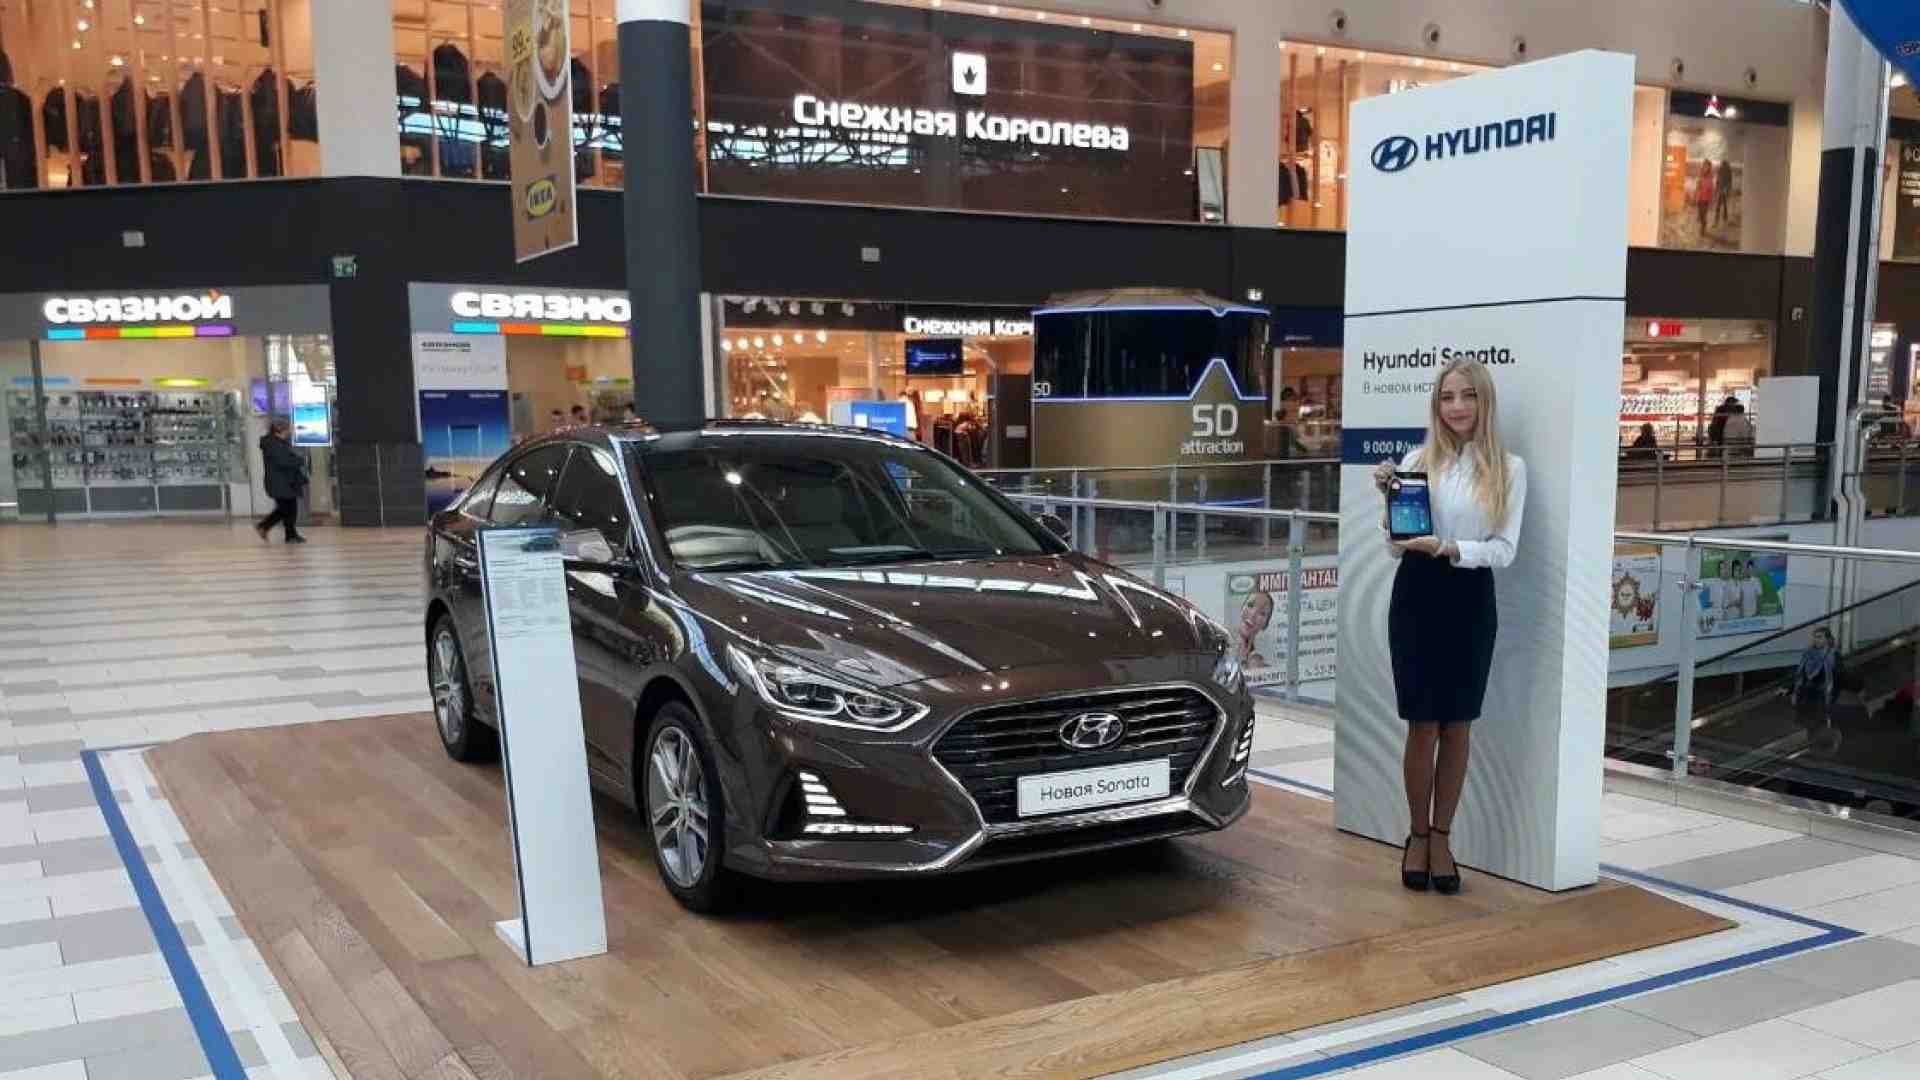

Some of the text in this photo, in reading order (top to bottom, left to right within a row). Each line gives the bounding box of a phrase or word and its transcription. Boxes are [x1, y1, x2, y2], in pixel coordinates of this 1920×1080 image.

[794, 95, 1129, 150] Снежная Королева
[1425, 112, 1556, 160] HYUNDAI
[44, 289, 232, 323] СВЯЗНОЙ
[904, 317, 991, 336] Снежная
[1363, 347, 1436, 375] Hyundai
[1363, 382, 1370, 393] В
[1192, 404, 1238, 436] 5D
[1181, 441, 1244, 454] attraction
[1363, 440, 1370, 454] 9
[1040, 775, 1150, 801] Новая Sonata
